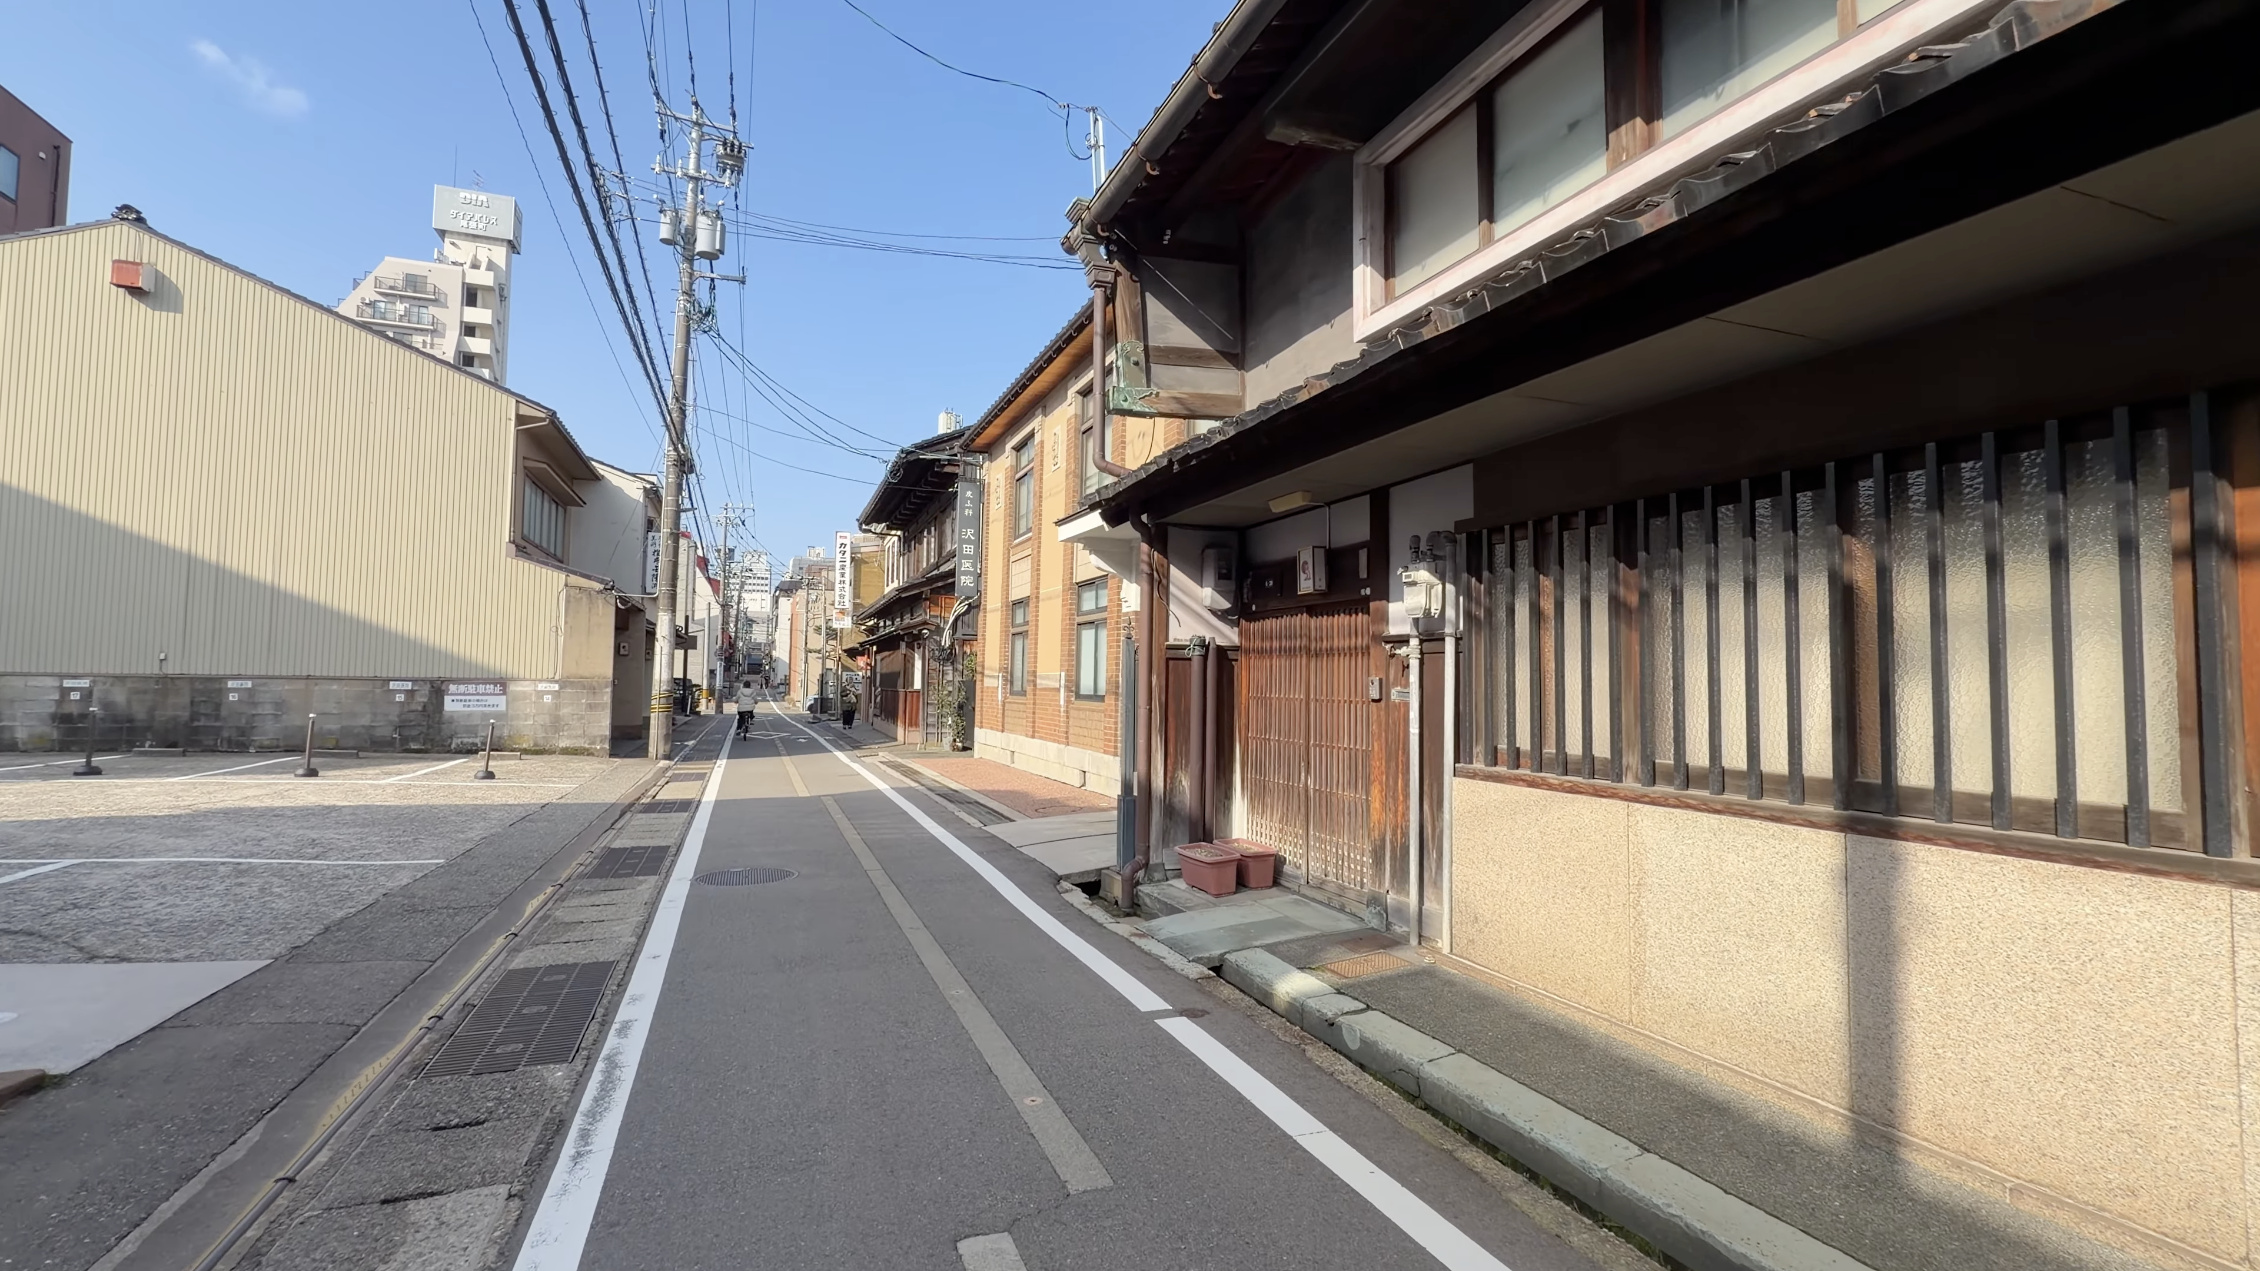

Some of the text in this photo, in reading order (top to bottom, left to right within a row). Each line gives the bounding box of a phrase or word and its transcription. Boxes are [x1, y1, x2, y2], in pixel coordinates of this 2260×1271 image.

[459, 192, 489, 207] DIA
[450, 209, 498, 226] ダイアパレス
[964, 490, 973, 516] 皮ふ科
[960, 528, 975, 586] 沢田医院
[837, 542, 848, 607] カタニ産業株式会社
[448, 683, 503, 694] 無断駐車禁止
